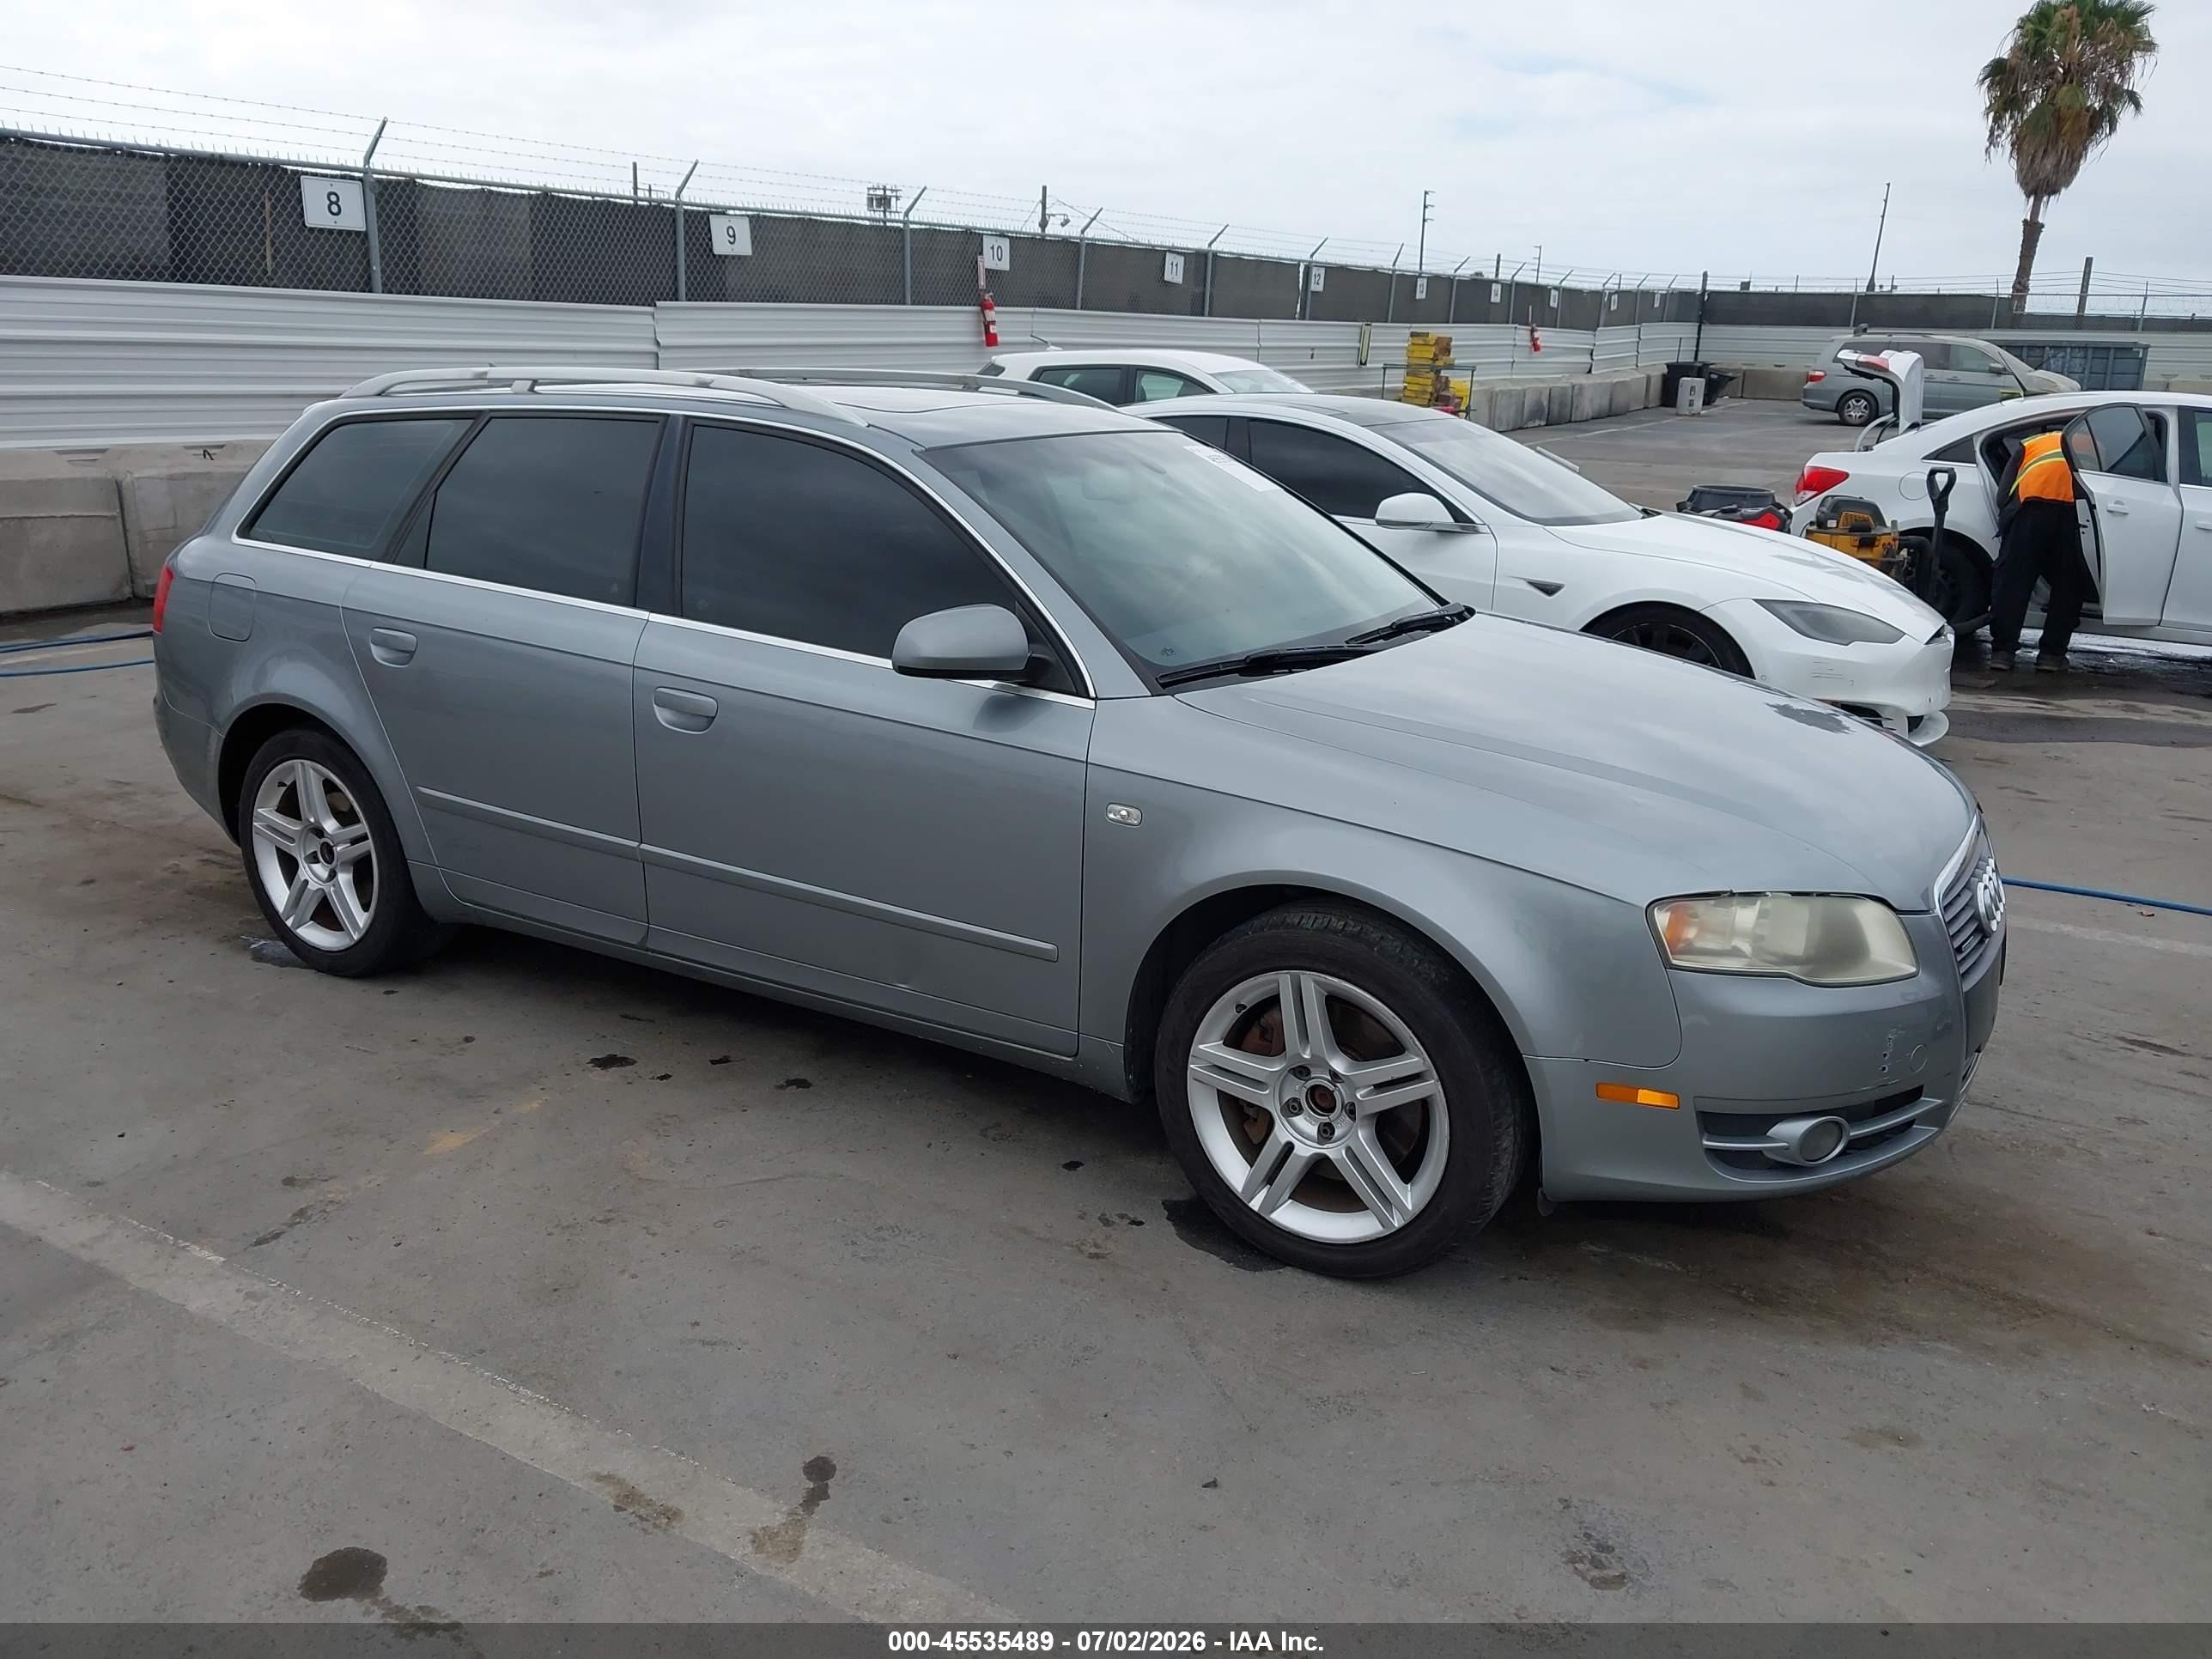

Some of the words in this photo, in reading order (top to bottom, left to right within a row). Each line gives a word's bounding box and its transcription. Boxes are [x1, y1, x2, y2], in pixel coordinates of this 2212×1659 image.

[326, 191, 342, 216] 8
[726, 225, 736, 245] 9
[990, 244, 1003, 262] 10
[1170, 260, 1179, 276] 11
[1313, 272, 1322, 285] 12
